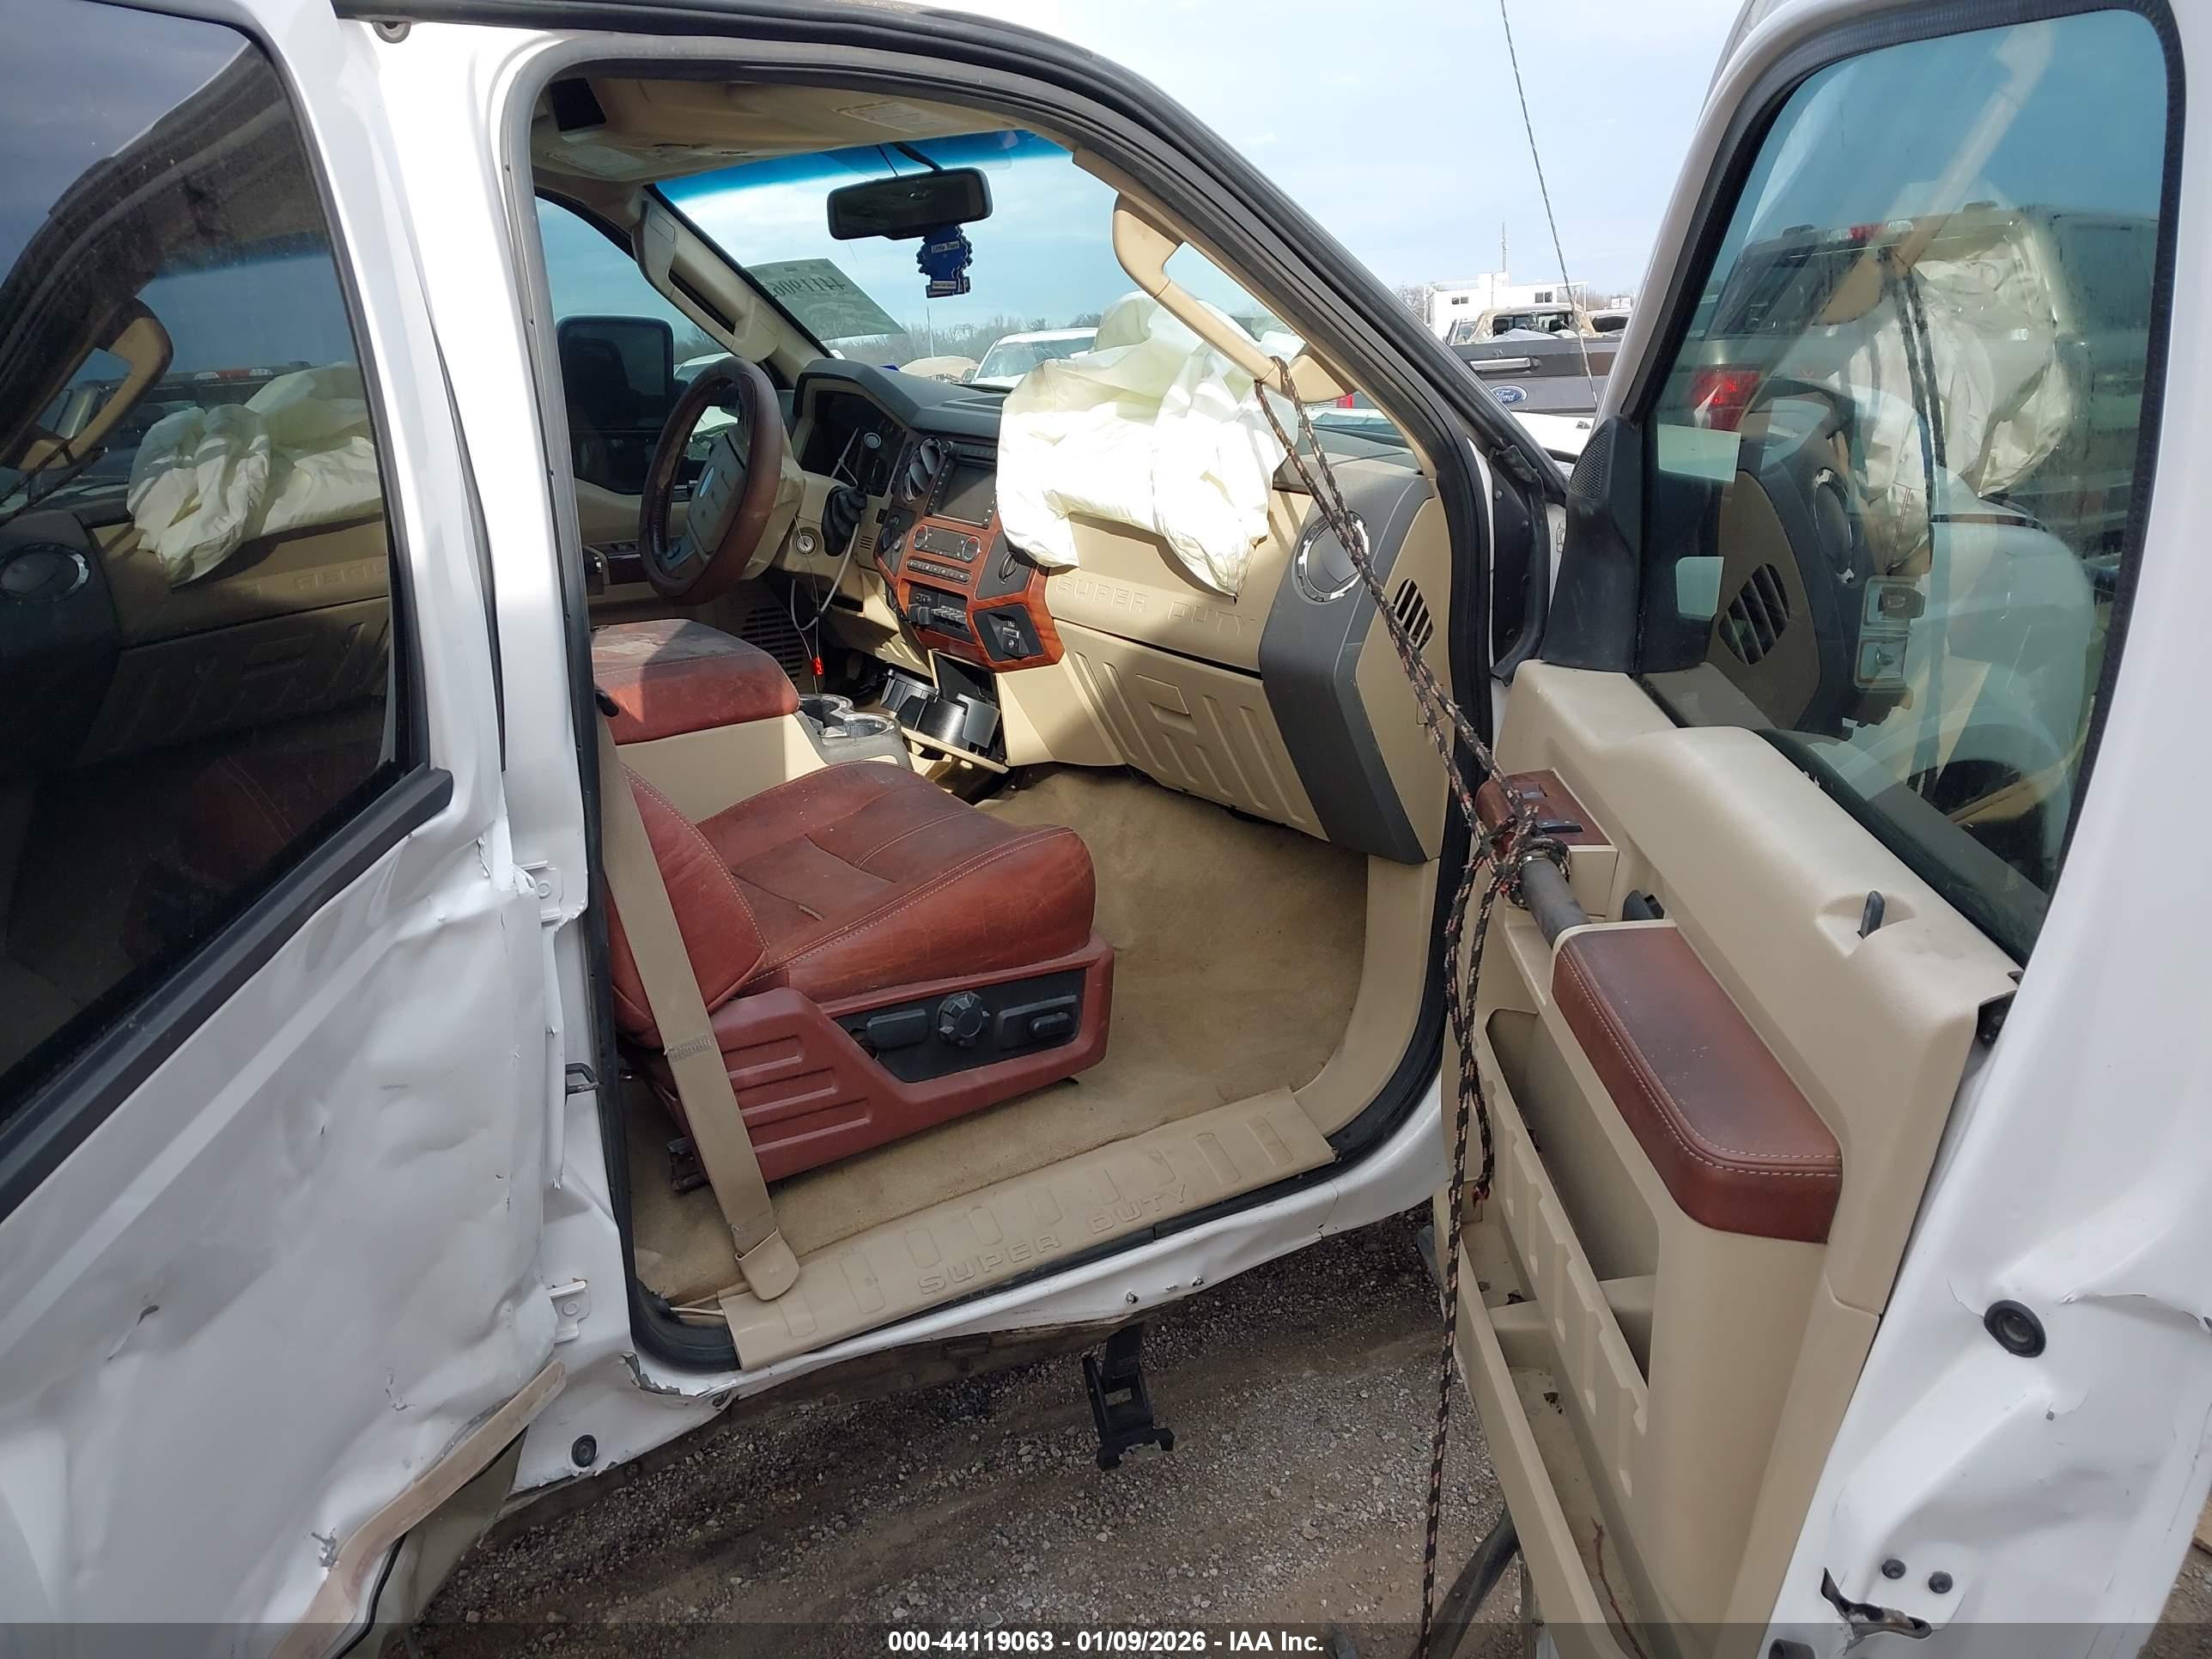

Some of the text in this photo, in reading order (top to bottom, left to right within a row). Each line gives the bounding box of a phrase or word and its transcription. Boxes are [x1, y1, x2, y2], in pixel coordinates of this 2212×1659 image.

[1496, 389, 1516, 402] Ford
[1055, 574, 1149, 614] SUPER
[917, 1184, 1189, 1295] SUPER DUTY
